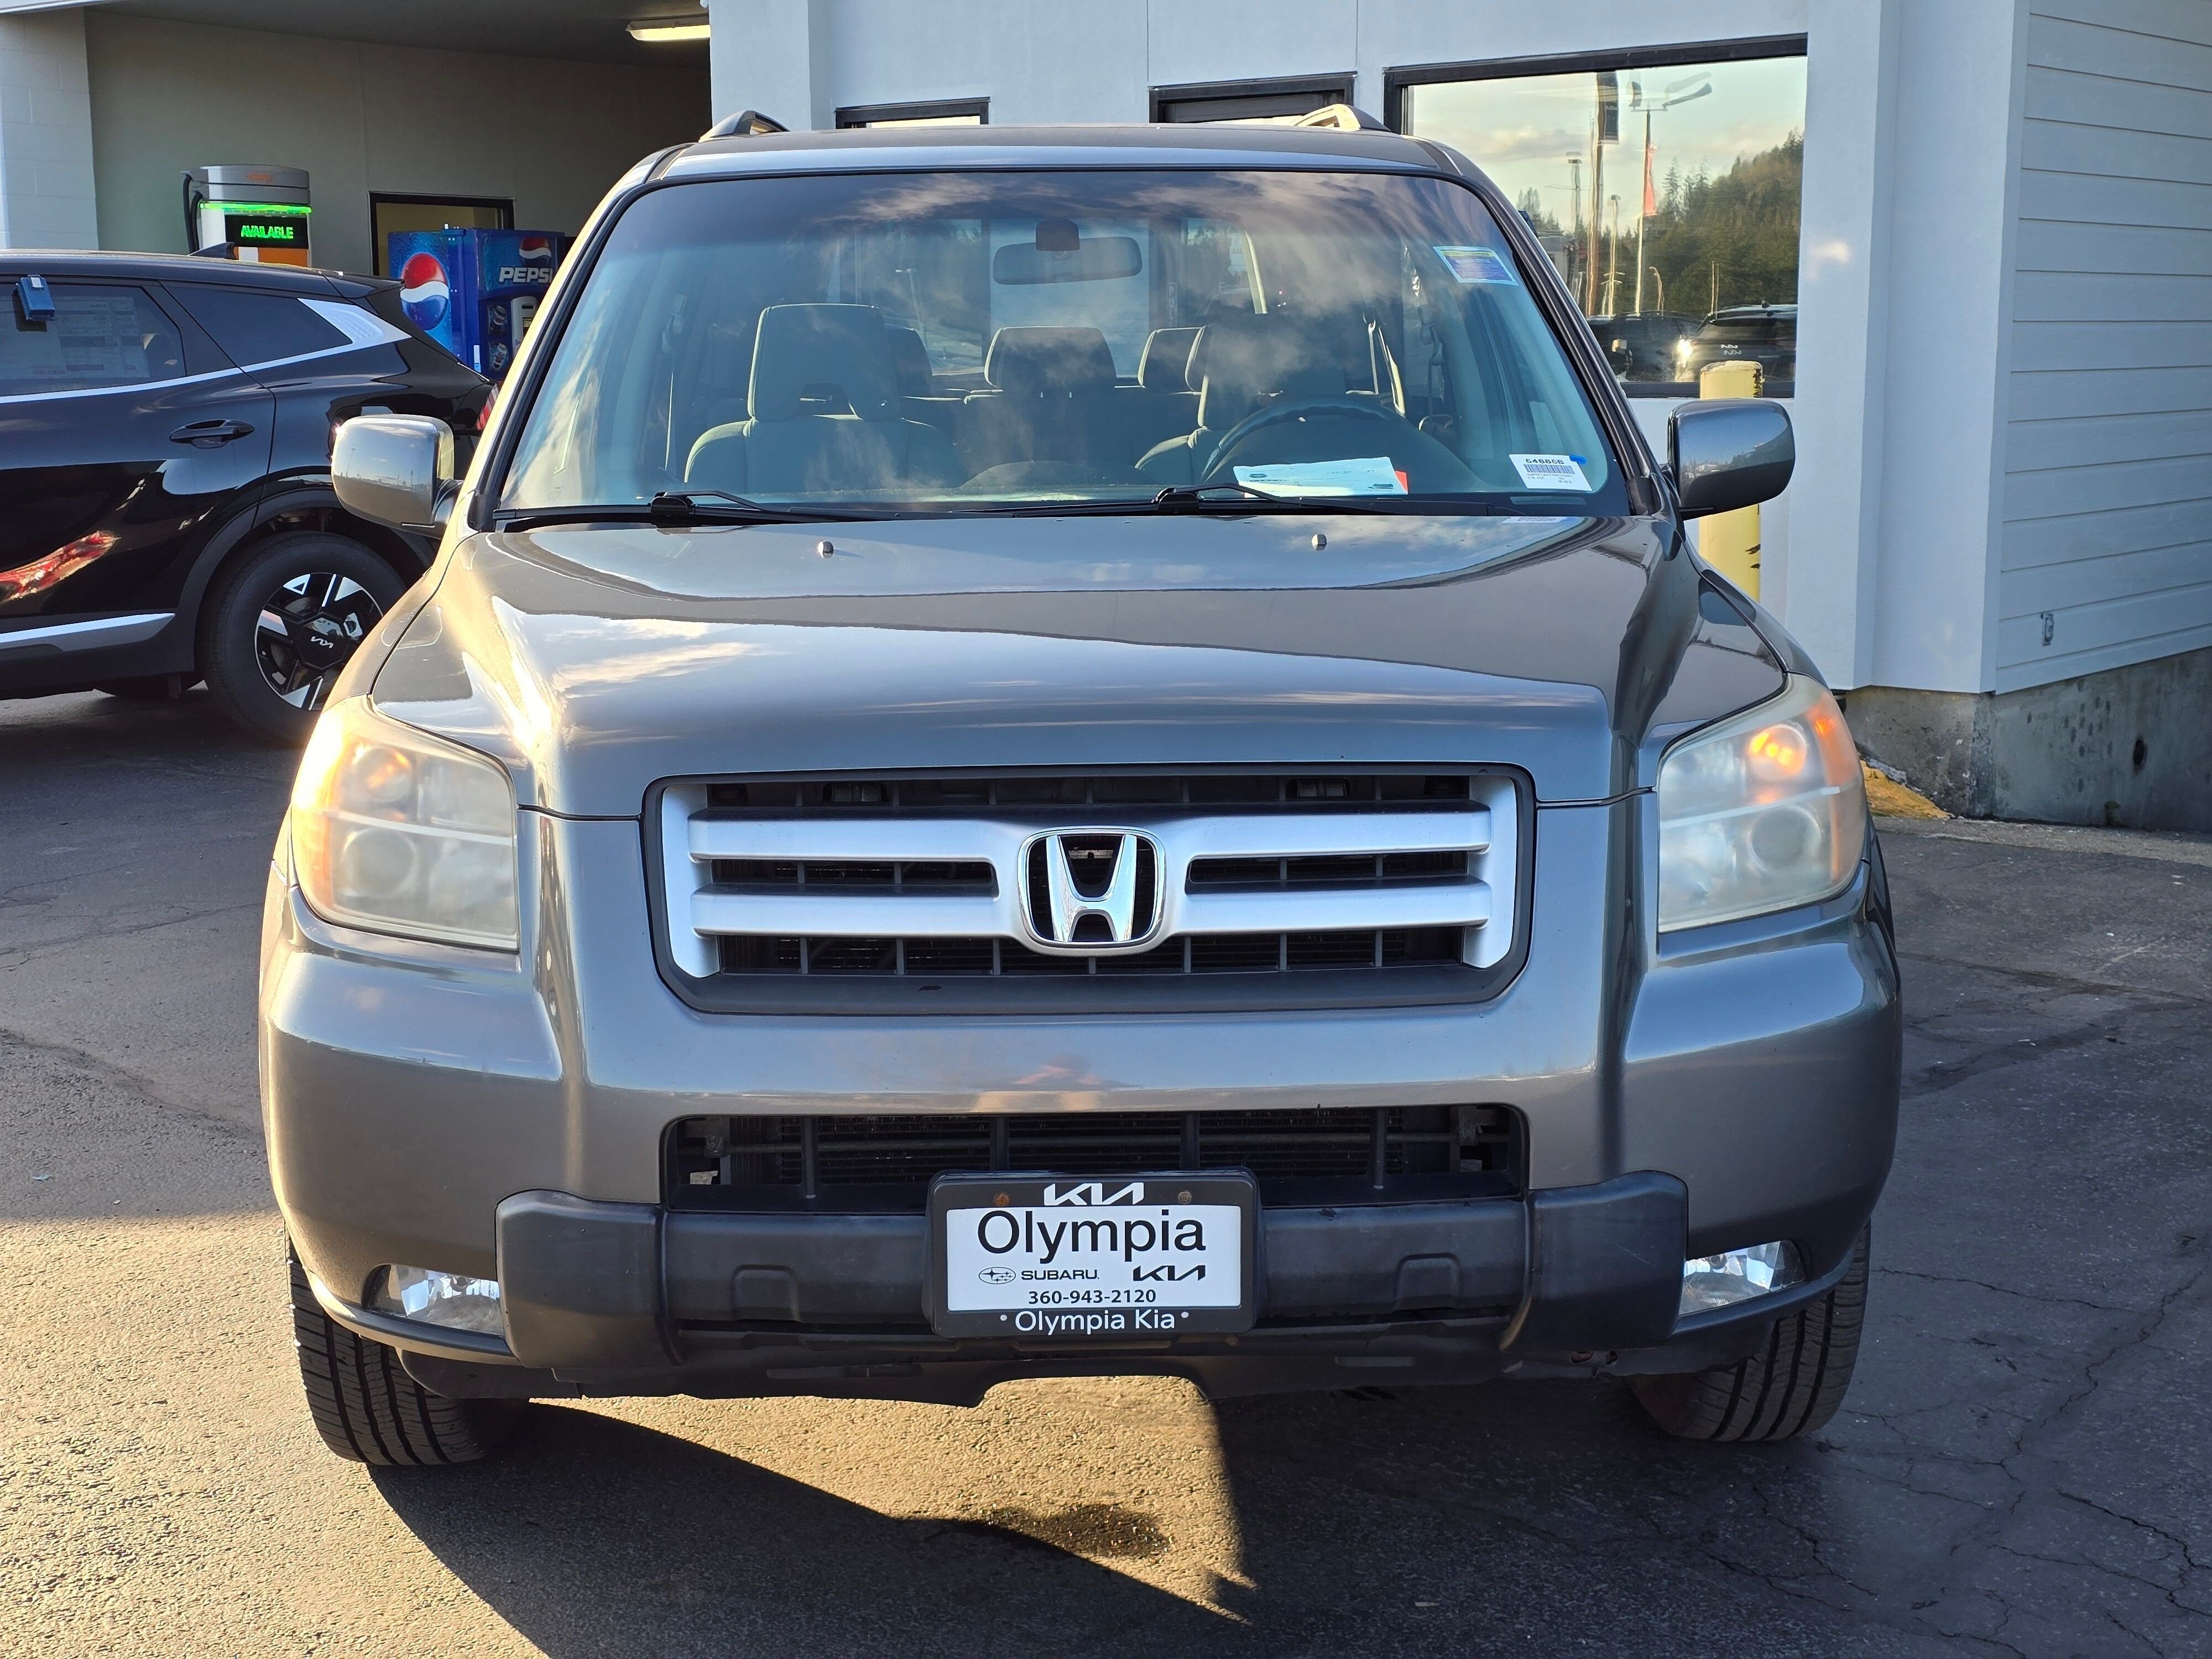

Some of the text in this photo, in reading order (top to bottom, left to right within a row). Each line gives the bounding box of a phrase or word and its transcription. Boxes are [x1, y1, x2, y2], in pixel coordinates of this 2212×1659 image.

[241, 225, 294, 239] AVAILABLE
[499, 267, 553, 284] PEPSI
[1044, 1182, 1144, 1206] KIA
[977, 1209, 1206, 1264] Olympia
[1133, 1265, 1206, 1281] KIA
[1028, 1289, 1157, 1305] 360-943-2120
[1015, 1308, 1175, 1335] Olympia Kia
